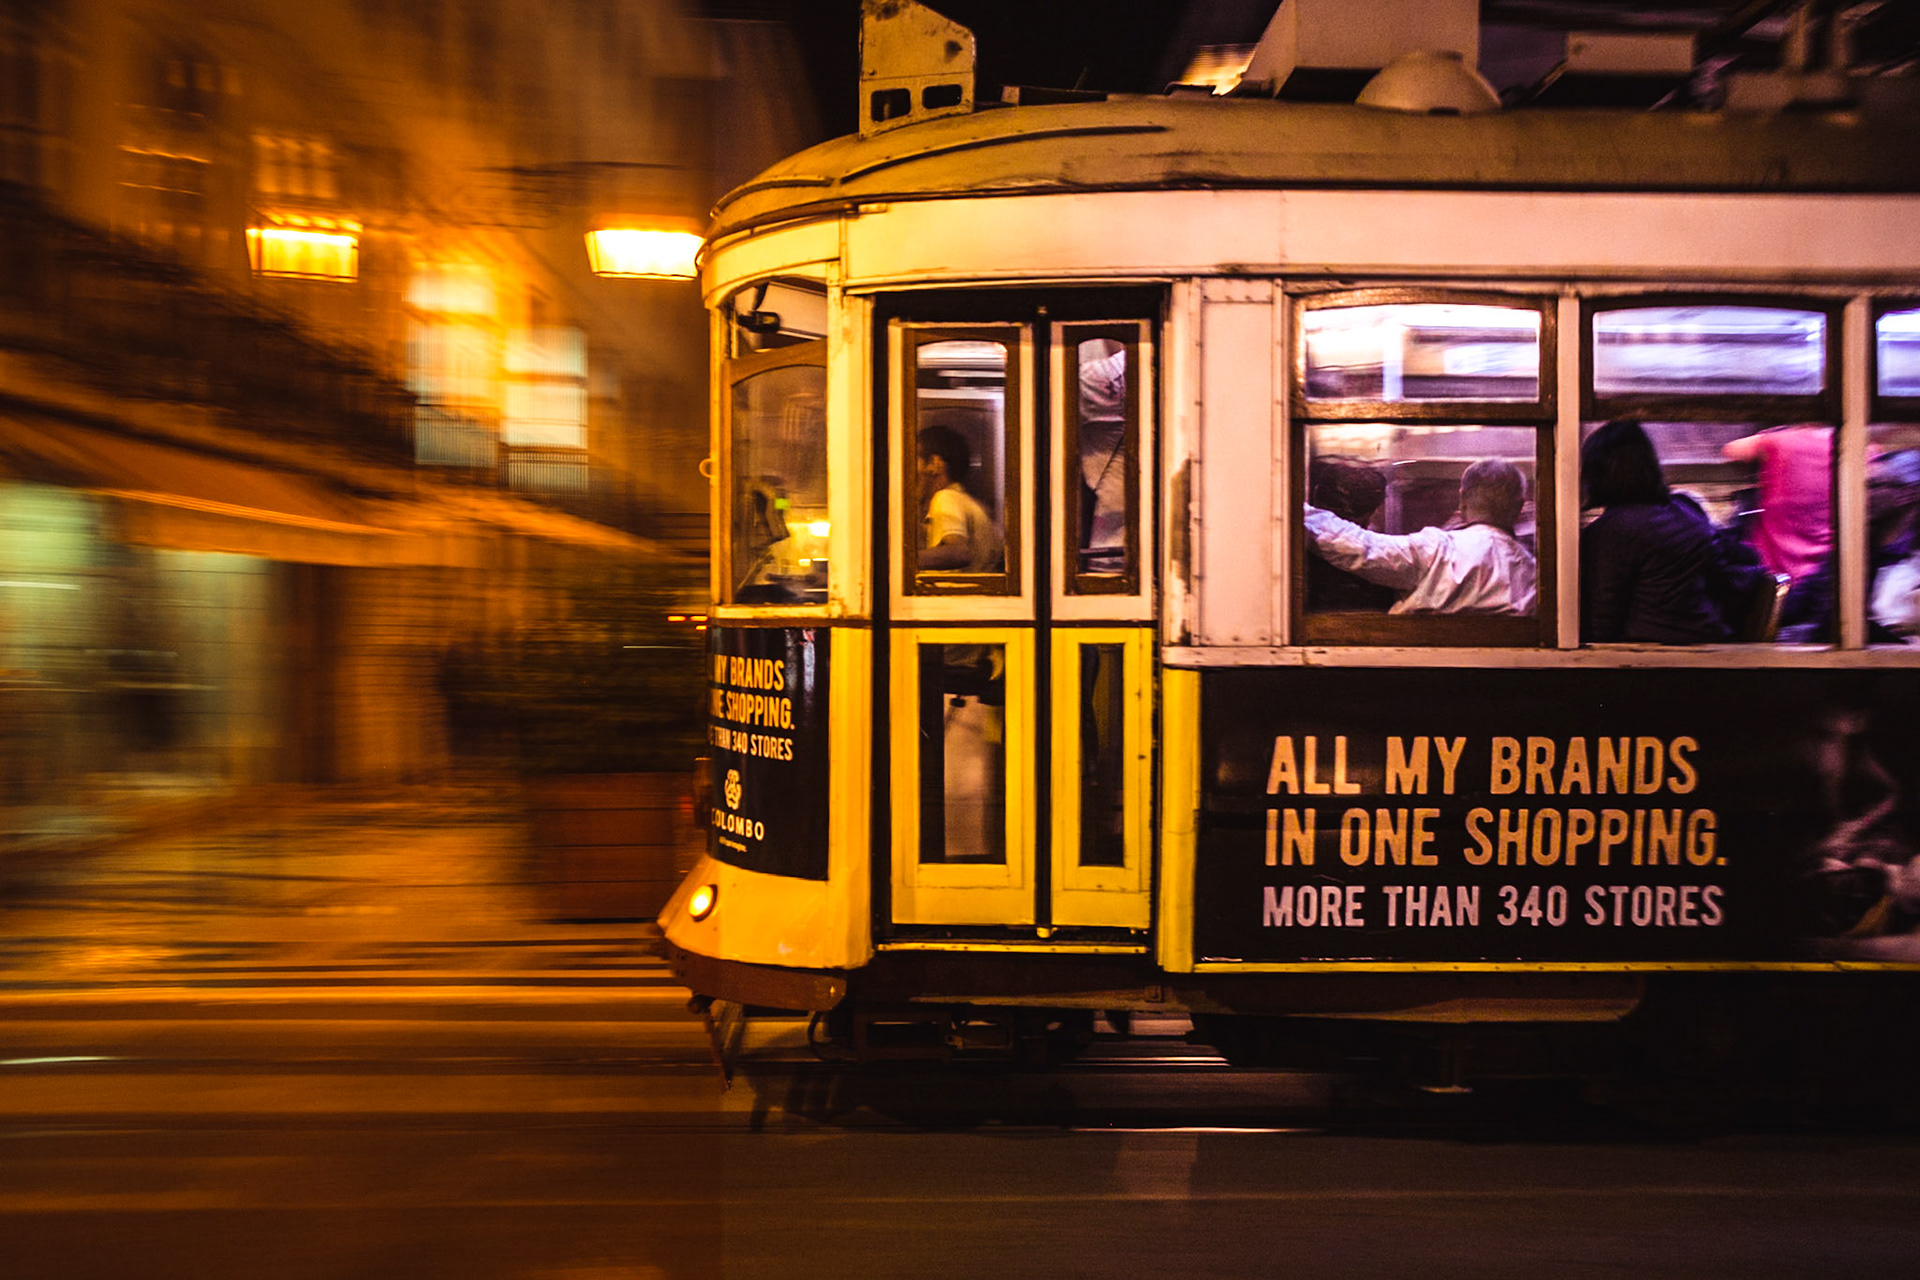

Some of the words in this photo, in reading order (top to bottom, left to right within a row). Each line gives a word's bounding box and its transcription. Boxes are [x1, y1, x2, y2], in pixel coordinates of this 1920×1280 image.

[730, 656, 785, 691] BRANDS
[726, 690, 795, 730] SHOPPING.
[732, 730, 748, 755] 340
[750, 733, 793, 761] STORES
[1266, 735, 1361, 795] ALL
[1385, 736, 1467, 795] MY
[1490, 736, 1700, 795] BRANDS
[1264, 808, 1317, 866] IN
[1340, 807, 1441, 867] ONE
[1463, 807, 1729, 867] SHOPPING.
[1263, 885, 1366, 927] MORE
[1382, 885, 1480, 927] THAN
[1497, 885, 1567, 927] 340
[1584, 885, 1725, 927] STORES
